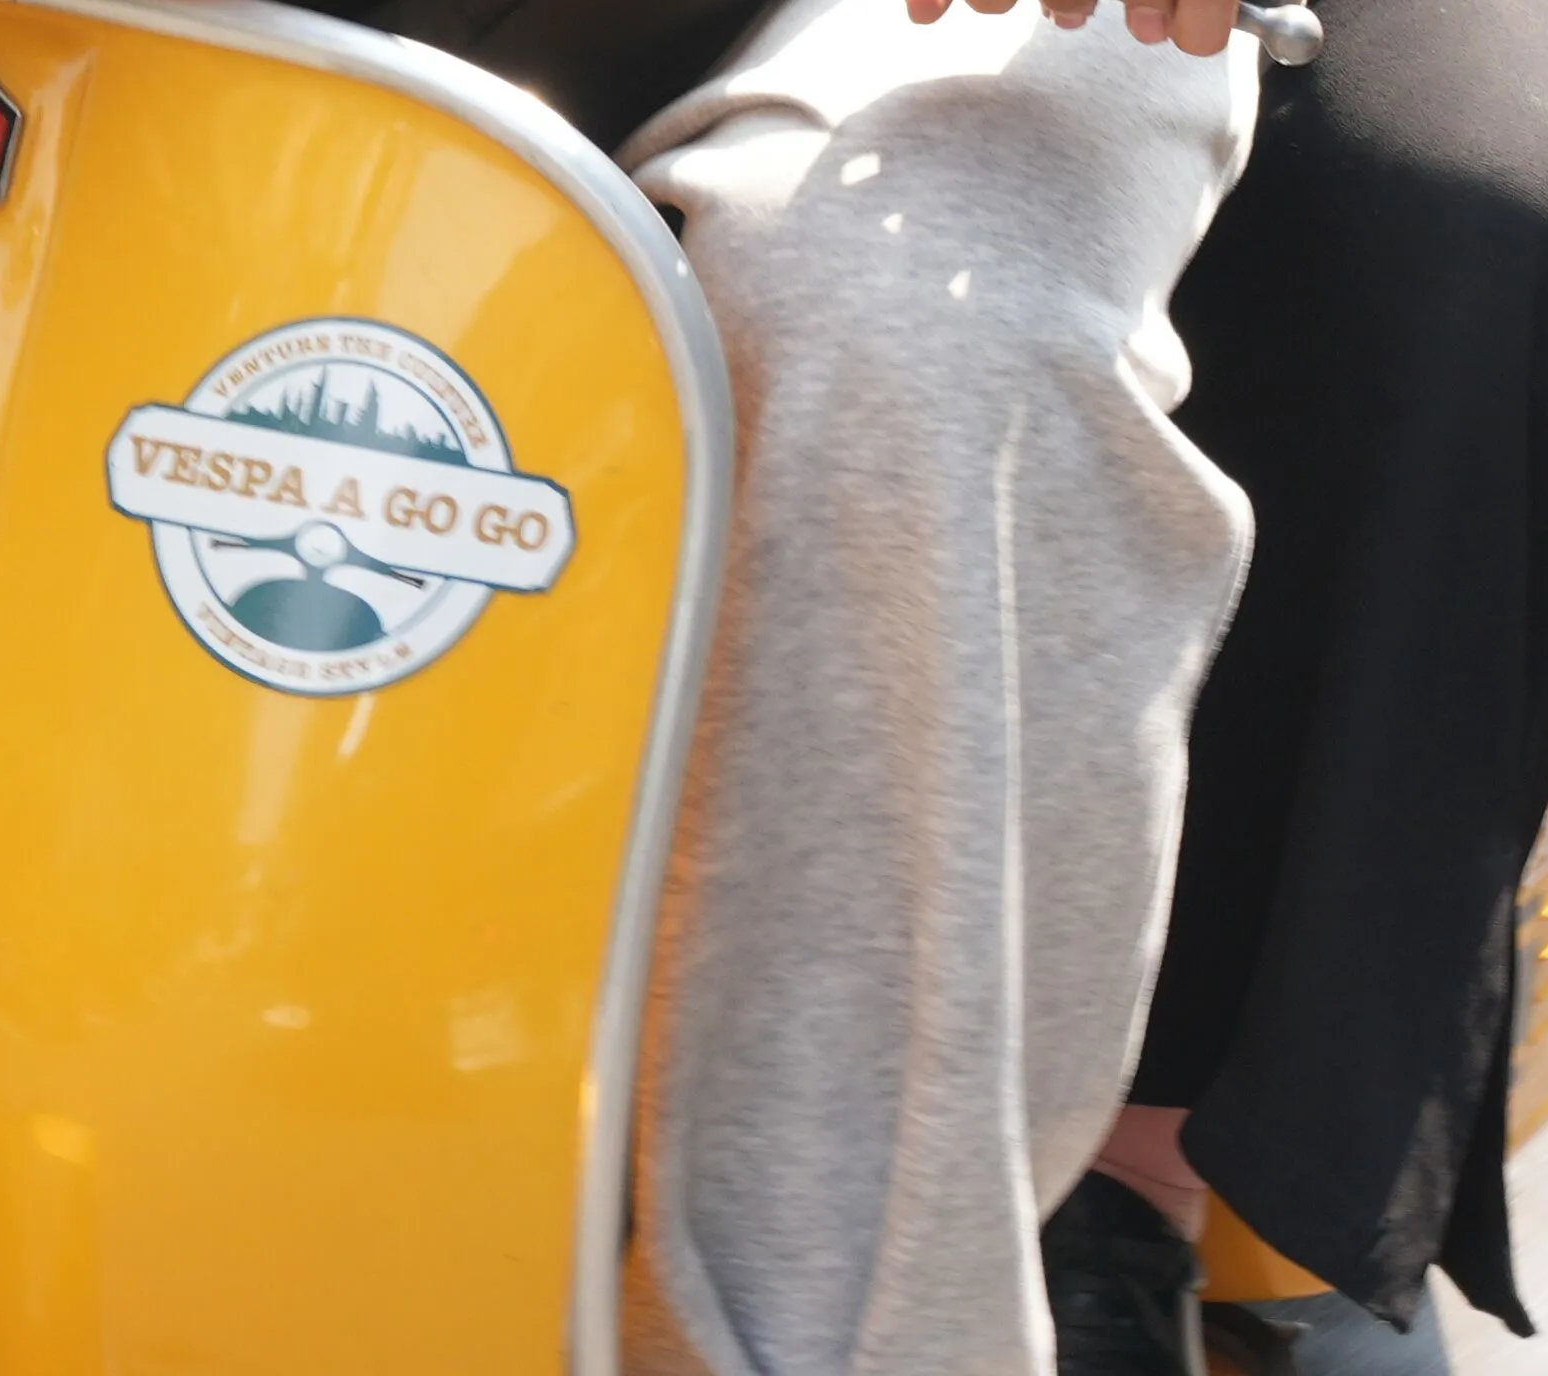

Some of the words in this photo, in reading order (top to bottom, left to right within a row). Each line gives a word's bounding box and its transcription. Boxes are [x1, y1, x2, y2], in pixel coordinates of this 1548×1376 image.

[130, 434, 309, 510] VESPA
[322, 476, 365, 521] A
[384, 485, 459, 536] GO
[473, 502, 549, 552] GO
